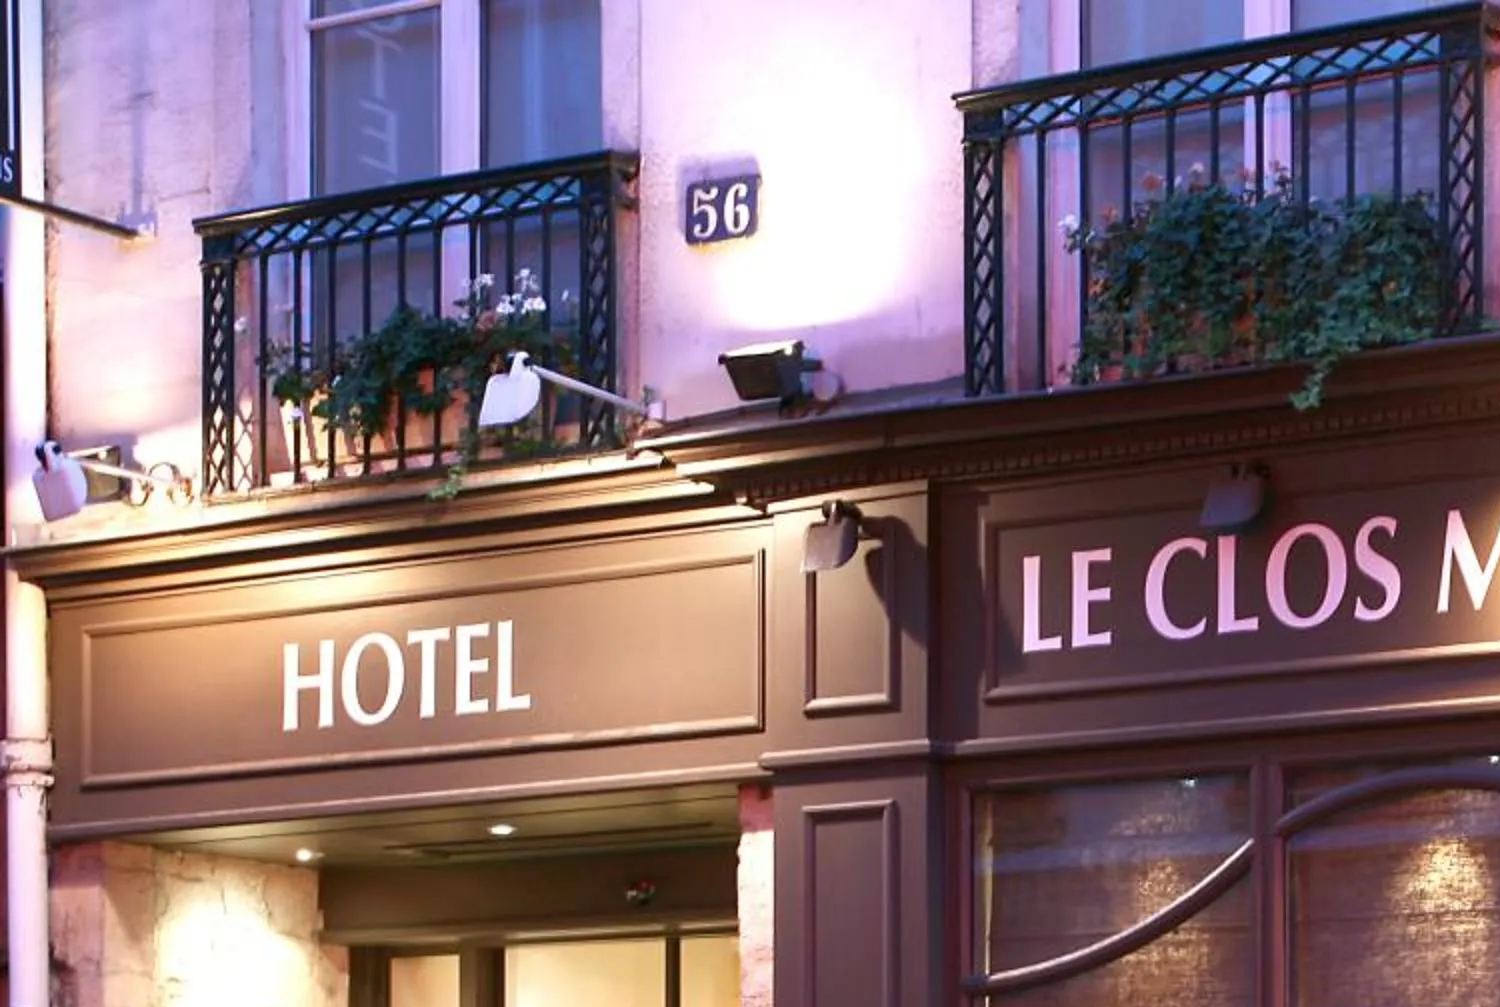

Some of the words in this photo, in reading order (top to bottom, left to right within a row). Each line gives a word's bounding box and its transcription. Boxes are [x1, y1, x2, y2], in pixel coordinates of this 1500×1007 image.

[693, 182, 750, 238] 56
[1022, 547, 1112, 653] LE
[1144, 515, 1401, 641] CLOS
[282, 619, 531, 732] HOTEL
